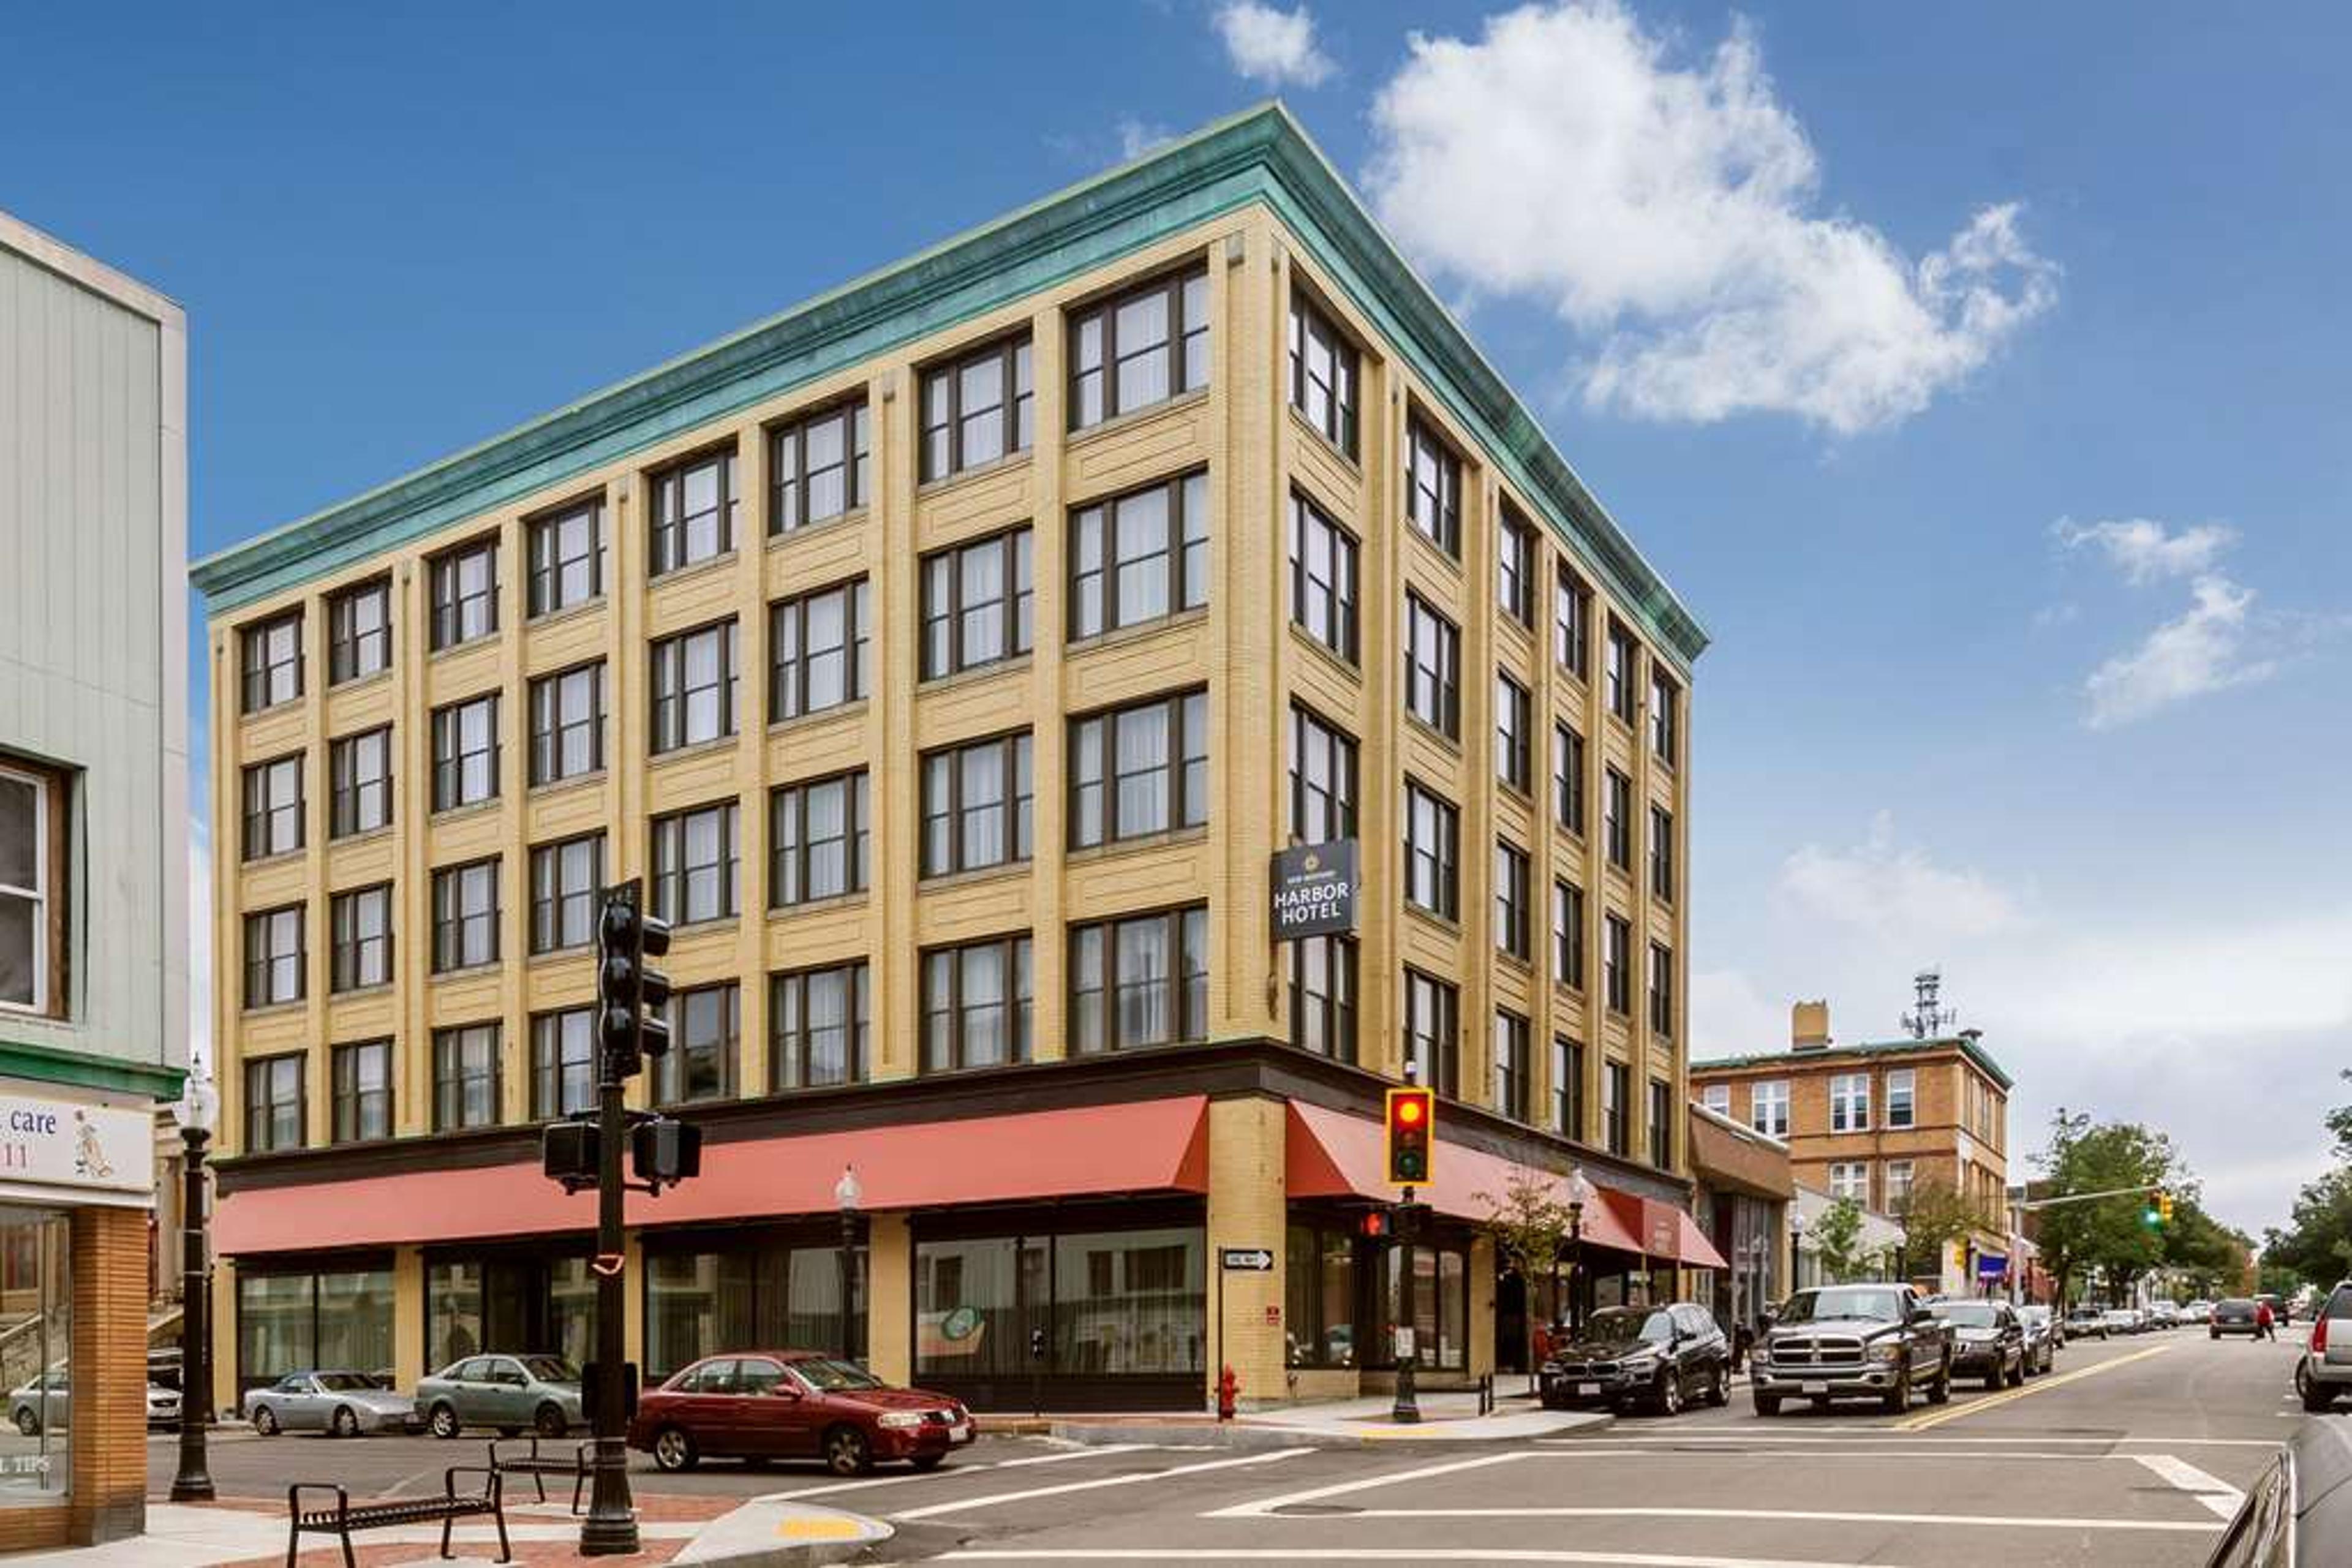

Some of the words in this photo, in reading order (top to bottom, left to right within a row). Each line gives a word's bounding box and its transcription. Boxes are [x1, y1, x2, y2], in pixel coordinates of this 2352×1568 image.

[1275, 882, 1349, 908] HARBOR
[1282, 902, 1341, 927] HOTEL
[10, 1109, 56, 1134] care
